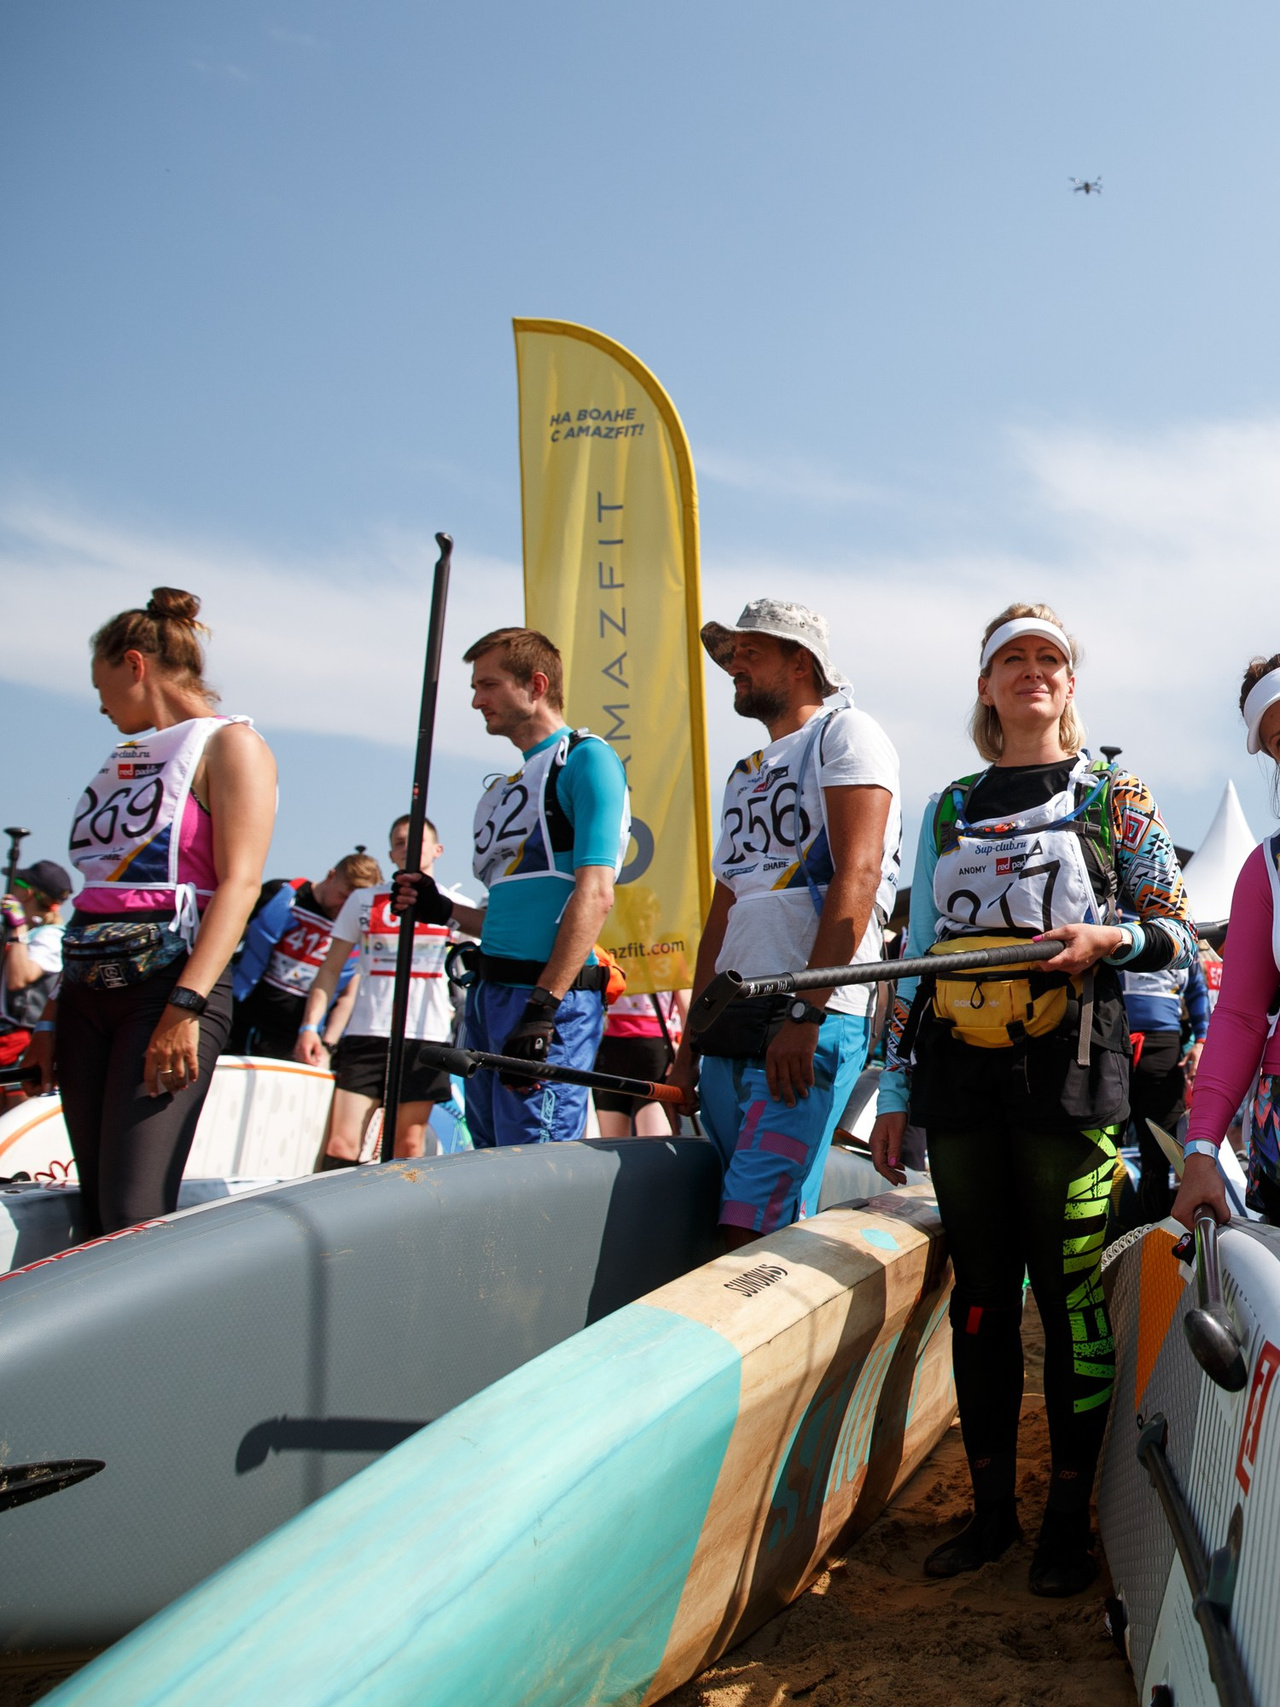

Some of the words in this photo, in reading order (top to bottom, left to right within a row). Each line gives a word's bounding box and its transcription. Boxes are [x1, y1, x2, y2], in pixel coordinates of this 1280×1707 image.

[549, 411, 572, 427] НА
[576, 407, 637, 423] ВОЛНЕ
[563, 423, 645, 441] AMAZFIT!
[69, 777, 164, 850] 269
[721, 781, 811, 865] 256
[975, 841, 1027, 855] Sup-club.ru
[958, 865, 987, 876] ANOMY
[997, 860, 1010, 871] red
[285, 926, 333, 961] 412
